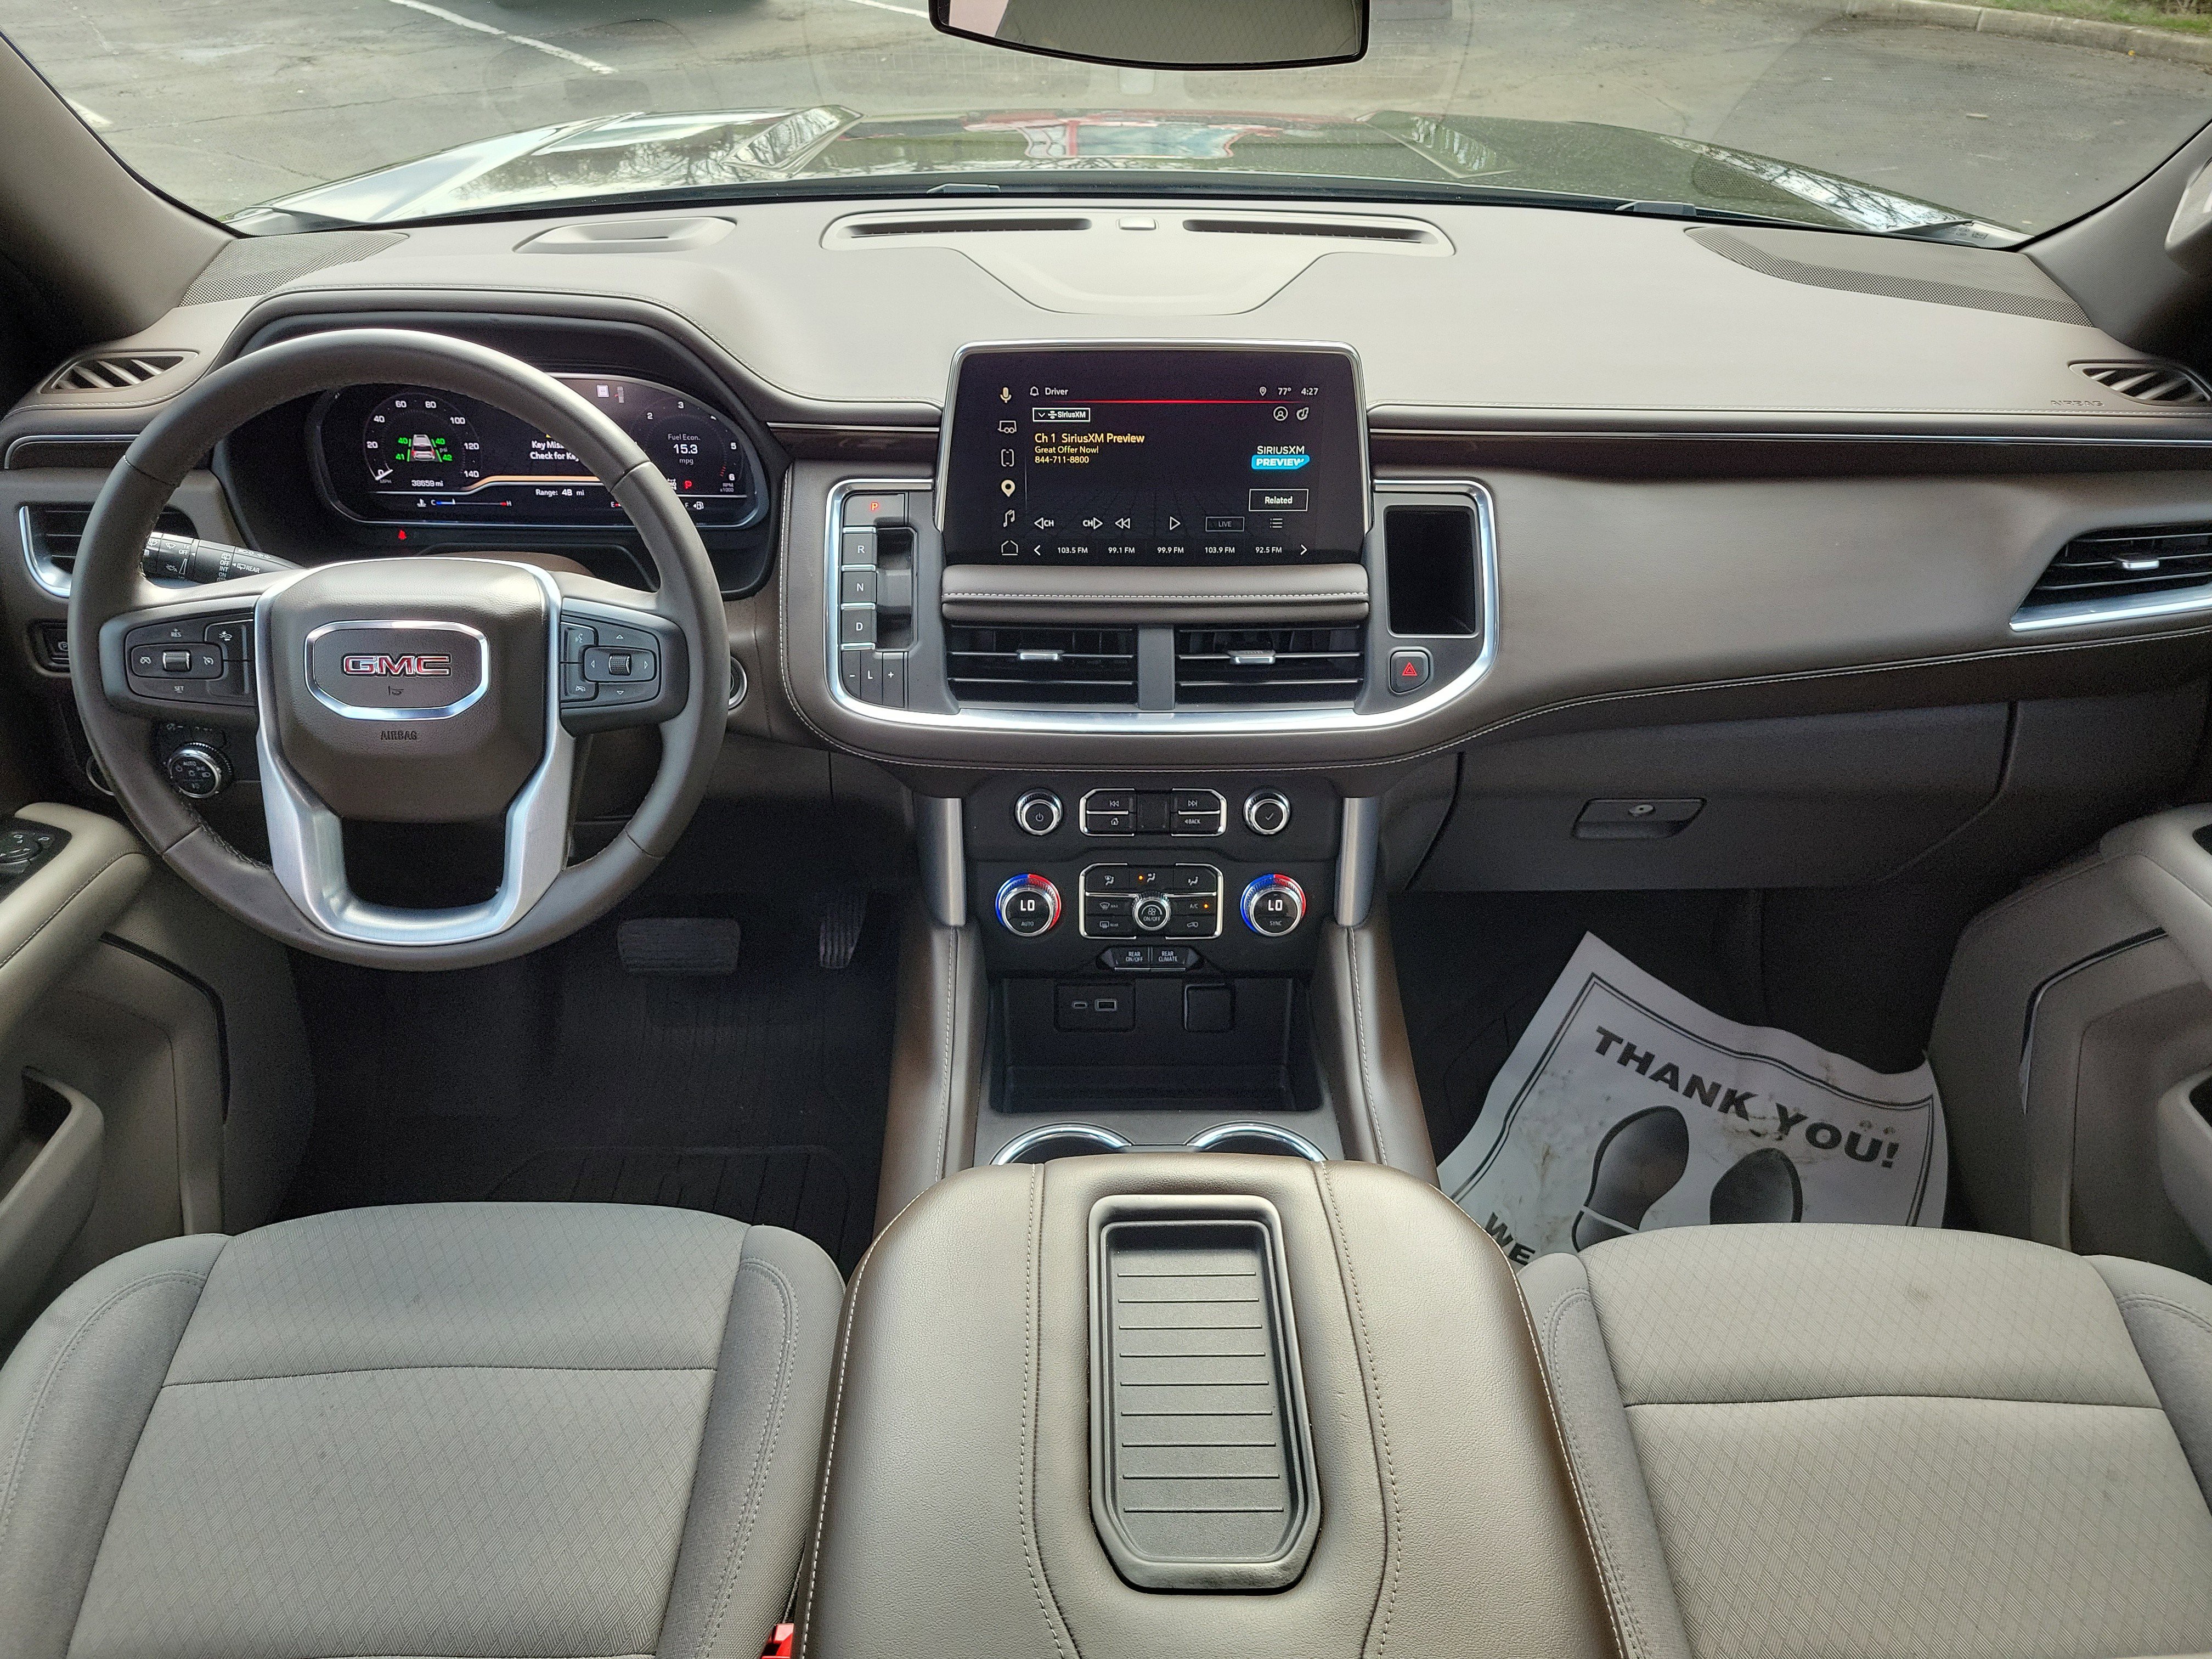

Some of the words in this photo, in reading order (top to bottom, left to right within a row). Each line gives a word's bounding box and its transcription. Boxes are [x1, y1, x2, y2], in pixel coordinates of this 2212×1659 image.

[1045, 387, 1069, 396] Driver
[678, 401, 685, 409] 3
[374, 415, 385, 423] 40
[450, 416, 466, 425] 100
[647, 412, 653, 420] 2
[1035, 433, 1048, 443] Ch
[1051, 433, 1056, 443] 1
[1061, 433, 1104, 443] SiriusXM
[1107, 433, 1145, 443] Preview
[464, 442, 479, 450] 120
[531, 440, 546, 450] Key
[673, 444, 698, 454] 15.3
[730, 442, 737, 450] 5
[1057, 445, 1078, 454] Offer
[1080, 445, 1099, 454] Now!
[1257, 445, 1305, 454] SIRIUSXM
[530, 451, 554, 460] Check
[554, 451, 566, 460] for
[1256, 458, 1305, 466] PREVIEW
[684, 480, 692, 489] P
[535, 488, 558, 497] Range:
[1265, 495, 1293, 504] Related
[871, 502, 879, 511] P
[857, 545, 865, 554] R
[246, 565, 260, 573] REAR
[856, 583, 864, 591] N
[855, 622, 864, 631] D
[343, 655, 450, 675] GMC
[867, 670, 873, 679] L
[380, 730, 417, 741] AIRBAG
[1020, 899, 1035, 911] LO
[1268, 899, 1283, 911] LO
[1594, 1025, 1759, 1121] THANK
[1775, 1102, 1900, 1169] YOU!
[1485, 1211, 1536, 1266] WE
